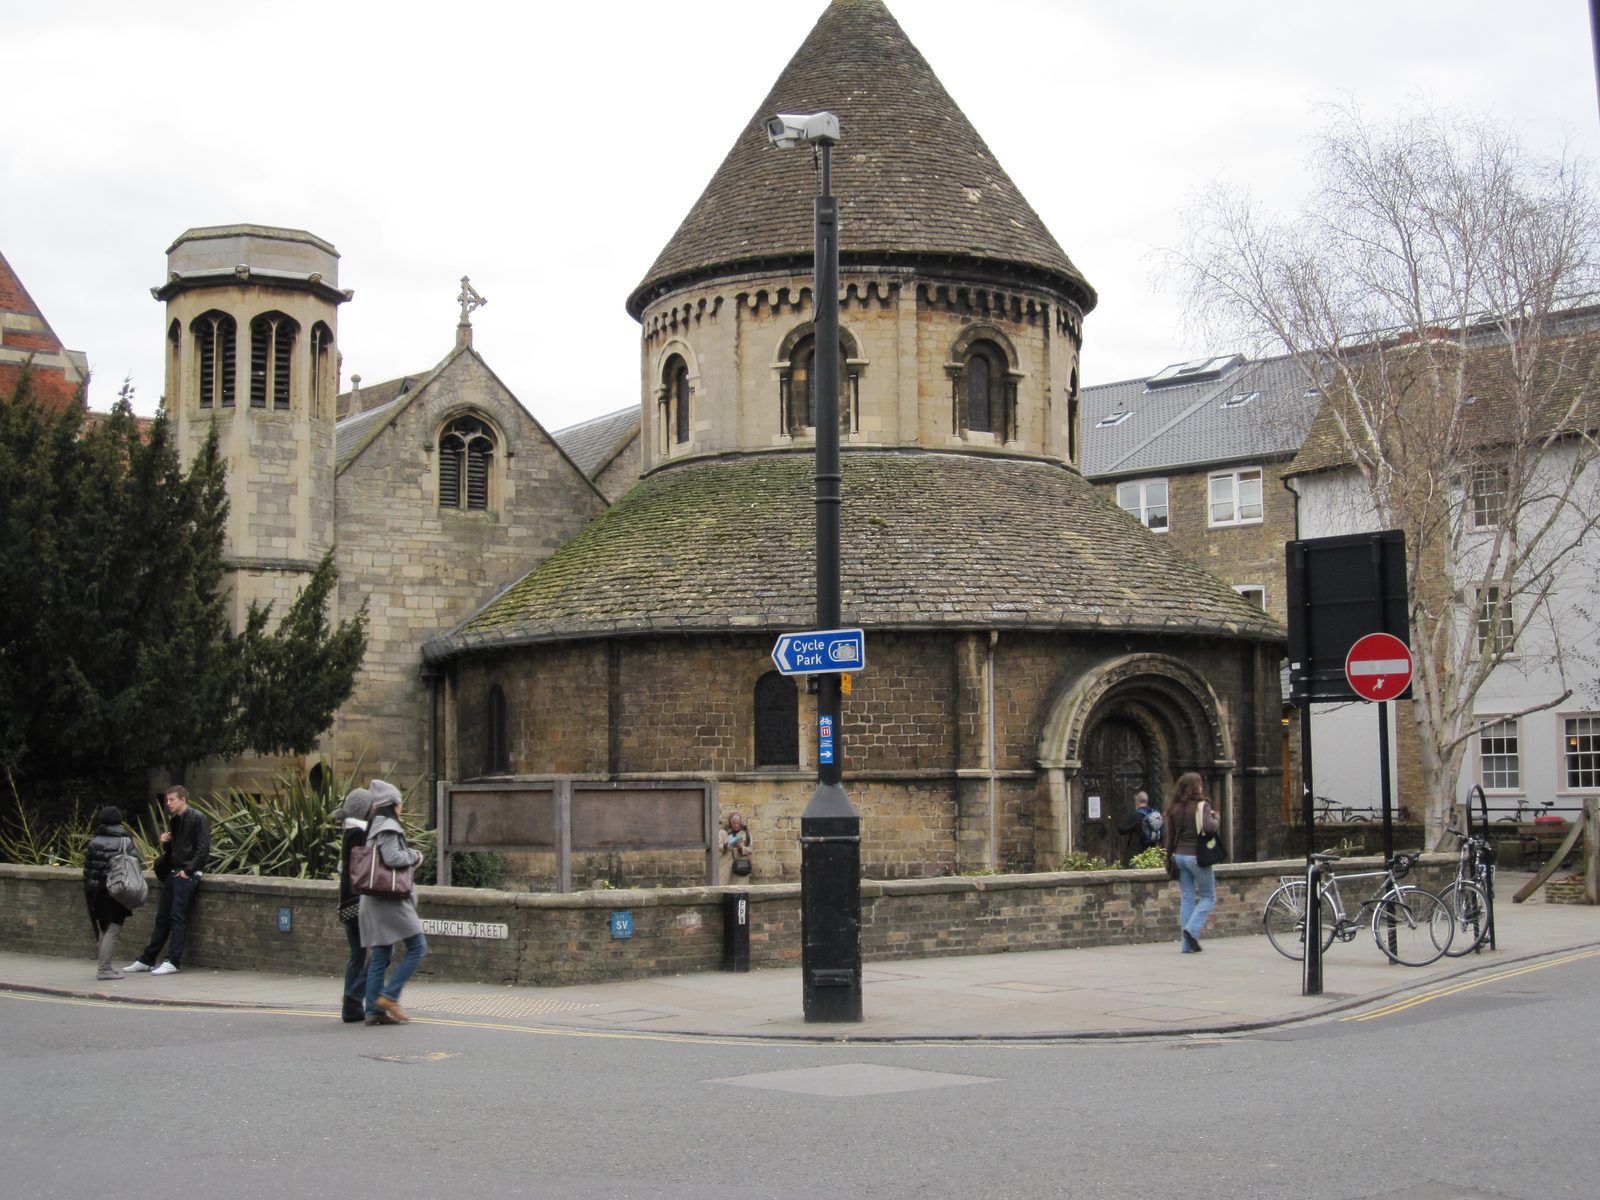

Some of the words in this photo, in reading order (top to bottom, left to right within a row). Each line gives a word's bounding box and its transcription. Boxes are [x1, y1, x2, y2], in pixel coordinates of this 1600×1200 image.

[793, 639, 825, 654] Cycle
[796, 653, 823, 666] Park
[822, 727, 829, 735] 11
[422, 920, 464, 935] CHURCH
[467, 923, 504, 938] STREET
[616, 920, 628, 930] SV
